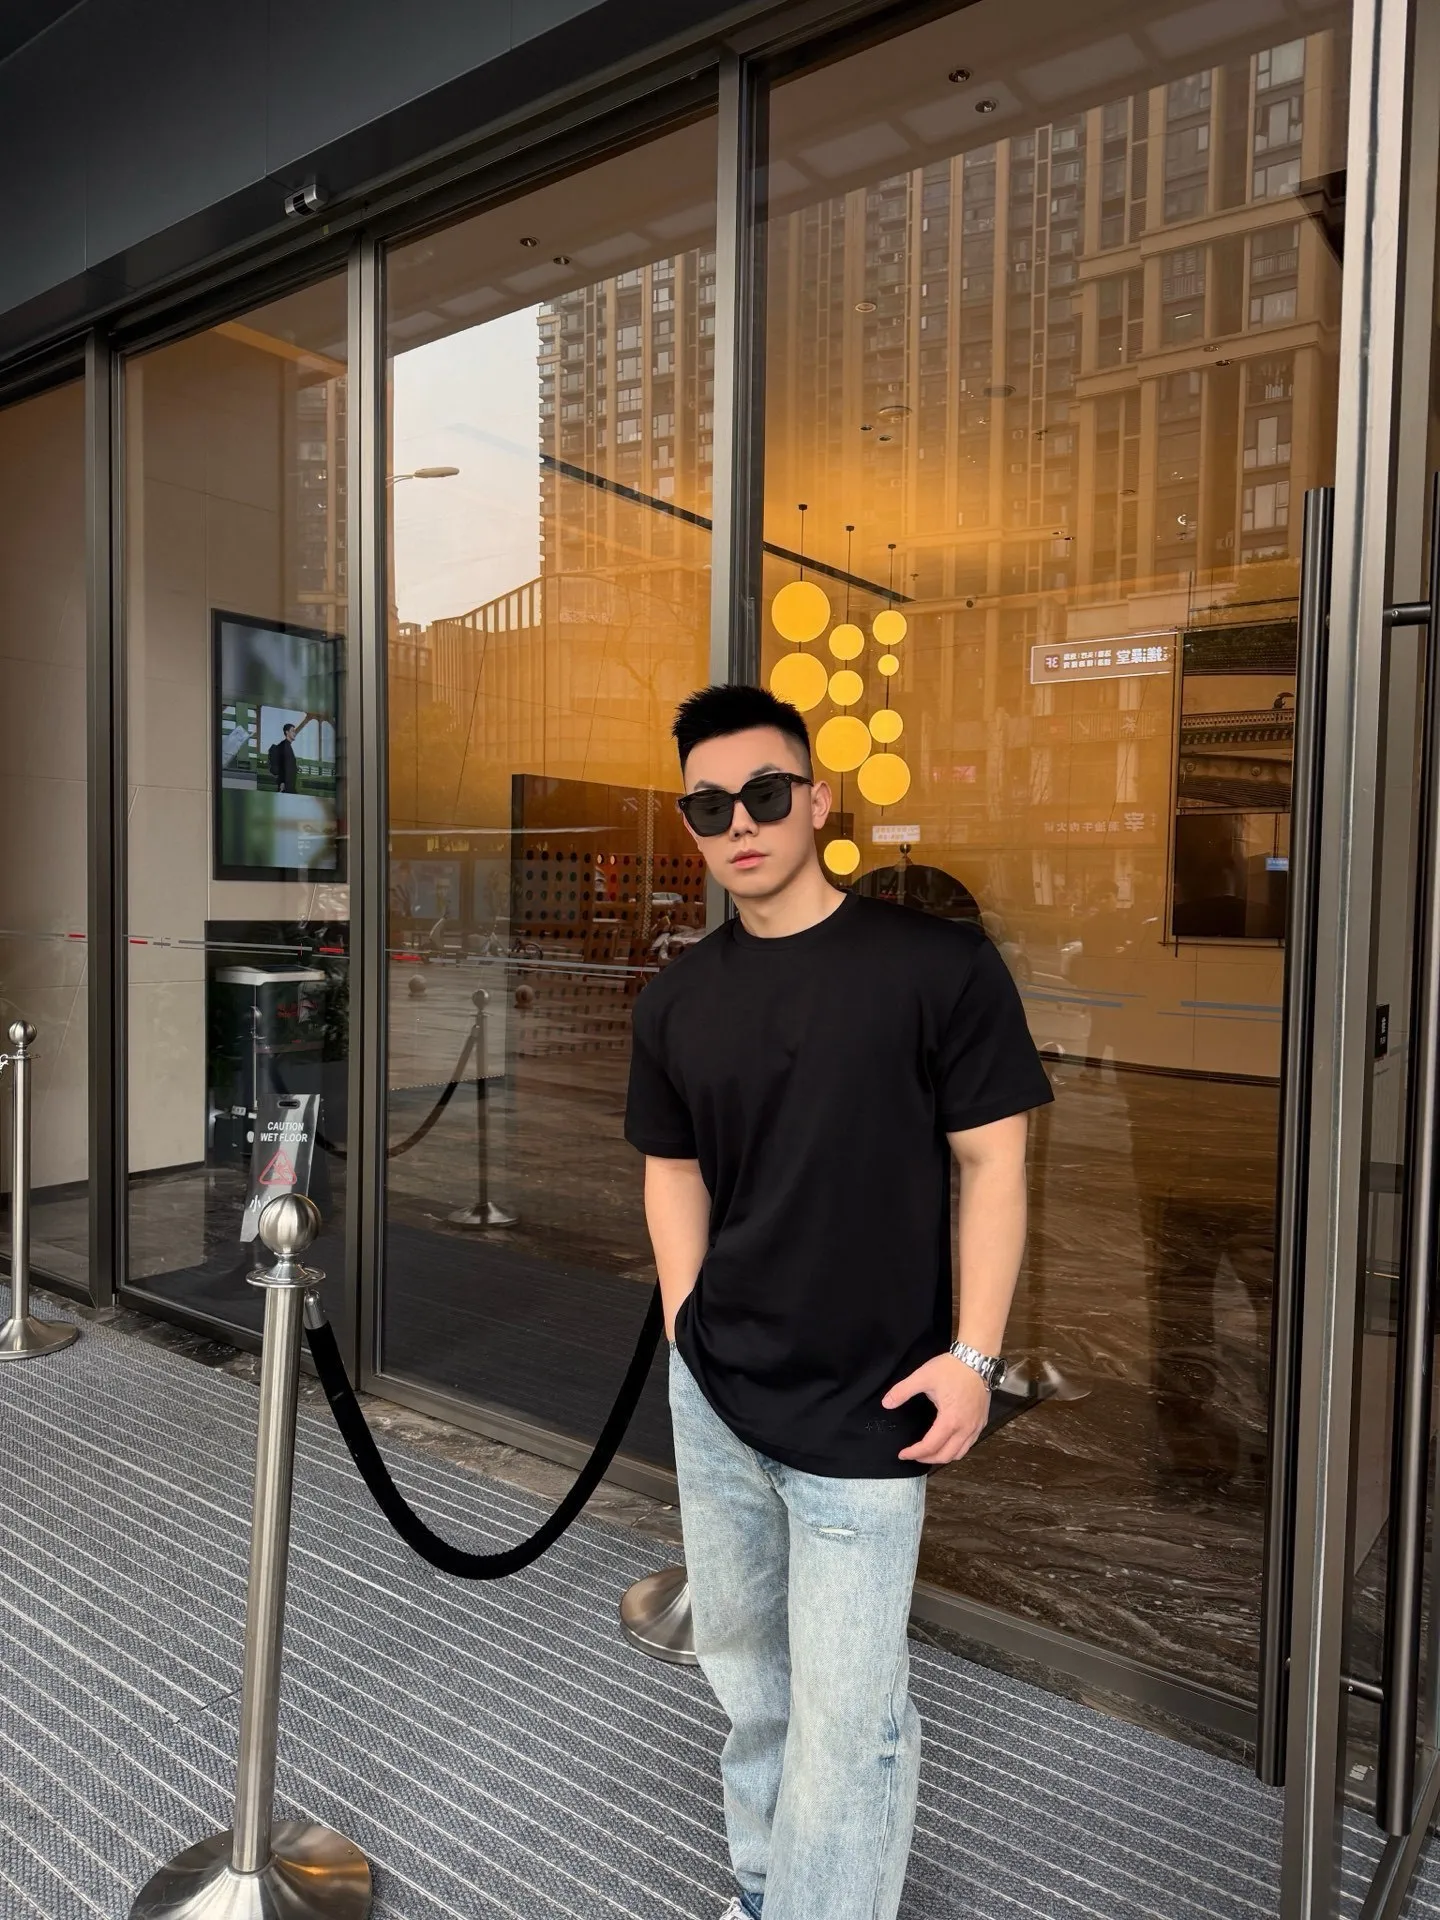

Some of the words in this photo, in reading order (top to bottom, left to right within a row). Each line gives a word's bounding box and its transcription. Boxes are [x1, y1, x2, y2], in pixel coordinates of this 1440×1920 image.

[267, 1121, 304, 1131] CAUTION
[260, 1132, 279, 1142] WET
[279, 1132, 308, 1142] FLOOR
